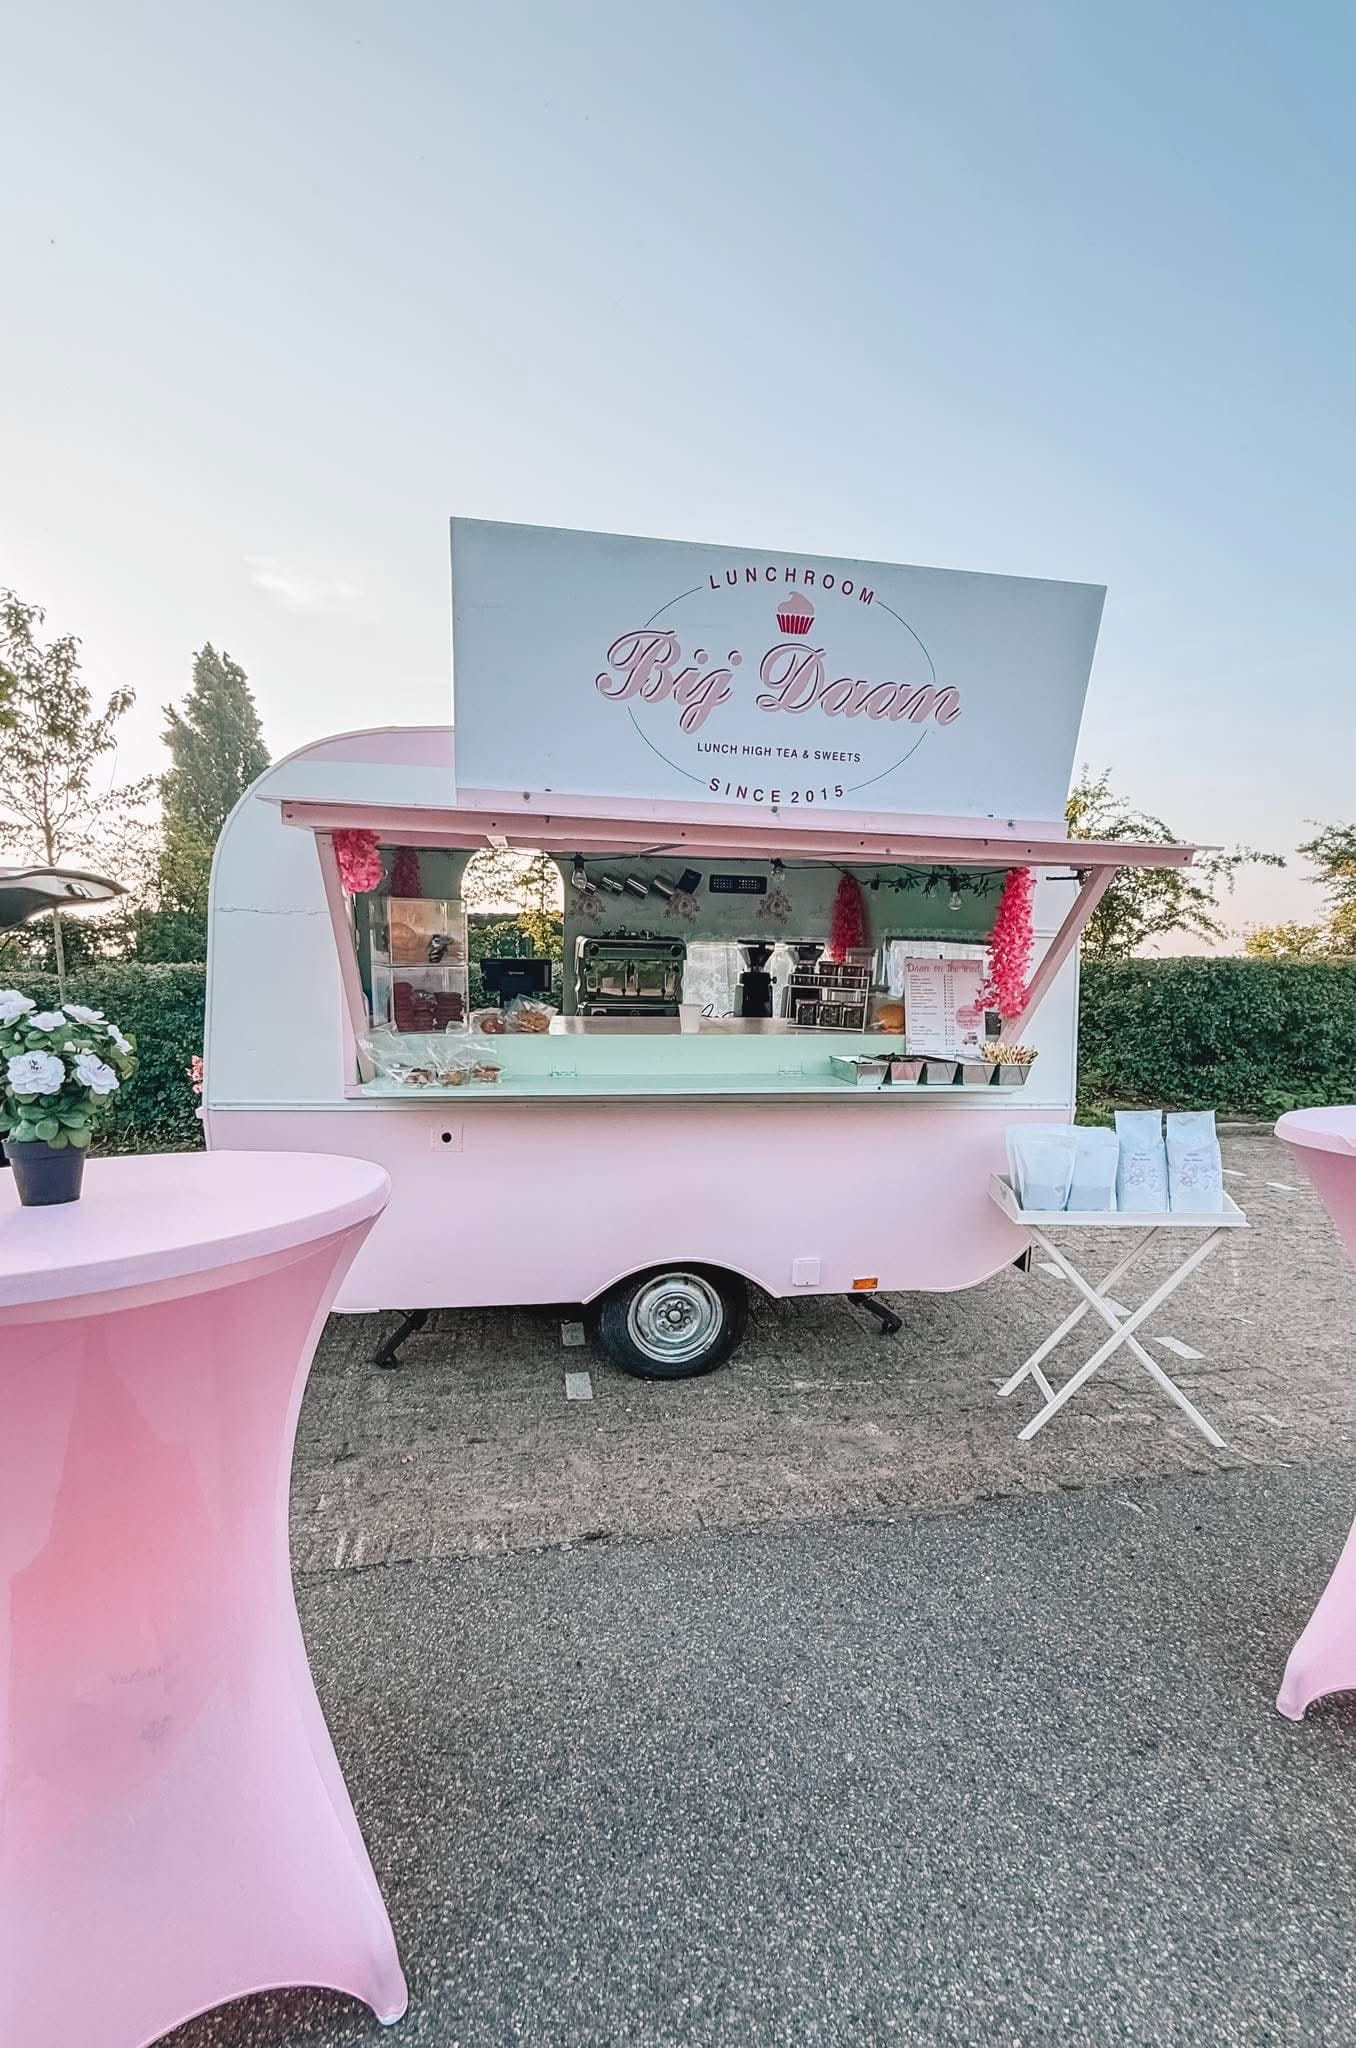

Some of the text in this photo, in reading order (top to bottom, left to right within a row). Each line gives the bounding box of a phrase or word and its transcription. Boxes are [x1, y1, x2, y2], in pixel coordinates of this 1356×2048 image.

[710, 566, 875, 605] LUNCHROOM
[595, 629, 962, 735] Bij Daan
[697, 742, 861, 763] LUNCH HIGH TEA & SWEETS
[709, 777, 844, 804] SINCE 2015
